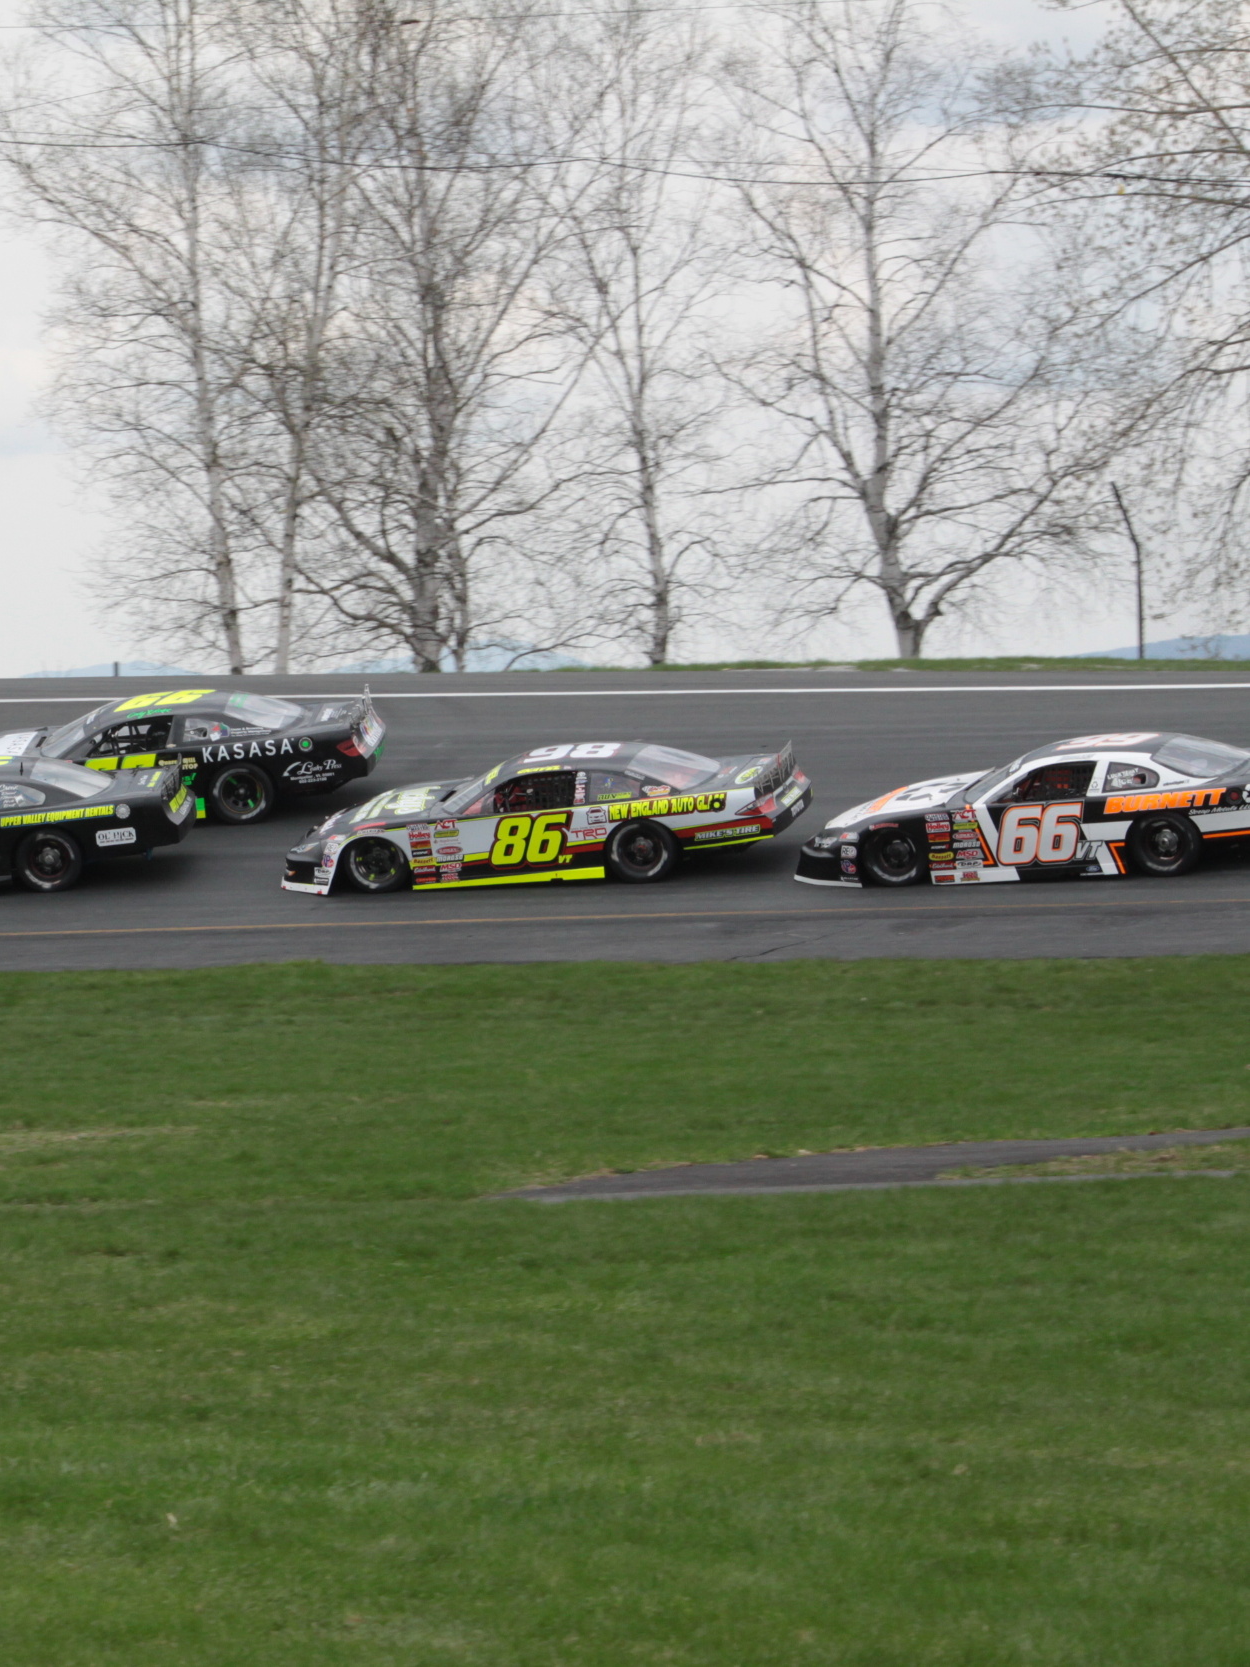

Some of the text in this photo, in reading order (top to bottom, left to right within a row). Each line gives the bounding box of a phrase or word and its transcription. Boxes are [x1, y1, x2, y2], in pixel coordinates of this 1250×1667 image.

[202, 738, 294, 763] KASASA
[609, 803, 629, 820] NEW
[630, 799, 669, 818] ENGLAND
[671, 796, 695, 813] AUTO
[1103, 787, 1227, 814] BURNETT
[0, 805, 114, 827] UPPER VALLEY EQUIPMENT RENTALS
[434, 819, 458, 830] ACT
[953, 809, 976, 819] ACT
[491, 812, 573, 867] 86 VT
[571, 828, 607, 840] TRD
[696, 825, 759, 839] MIKE'S TIRE
[998, 801, 1103, 865] 66 VT
